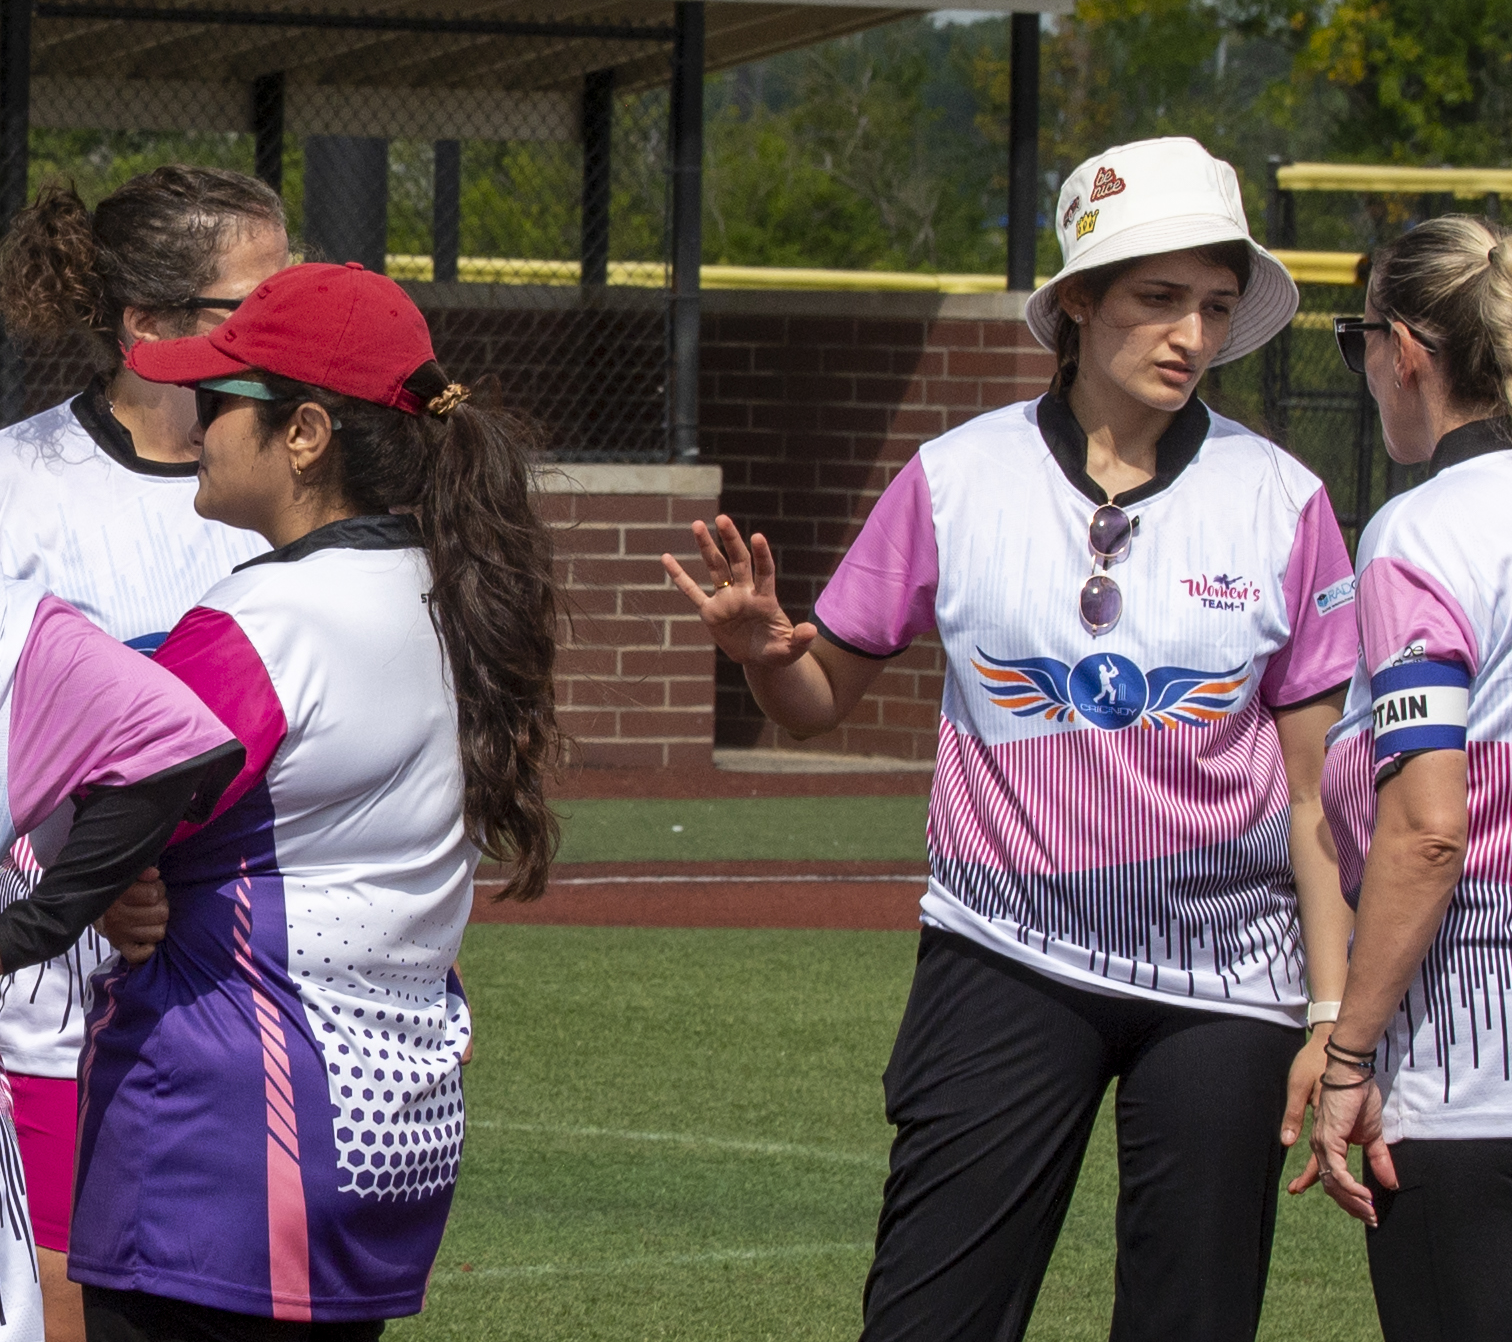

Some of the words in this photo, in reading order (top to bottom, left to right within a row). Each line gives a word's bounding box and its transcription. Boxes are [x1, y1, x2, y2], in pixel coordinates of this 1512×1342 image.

[1095, 170, 1112, 187] be
[1090, 179, 1121, 201] nice
[1179, 573, 1261, 602] Women's
[1201, 597, 1245, 612] TEAM-1
